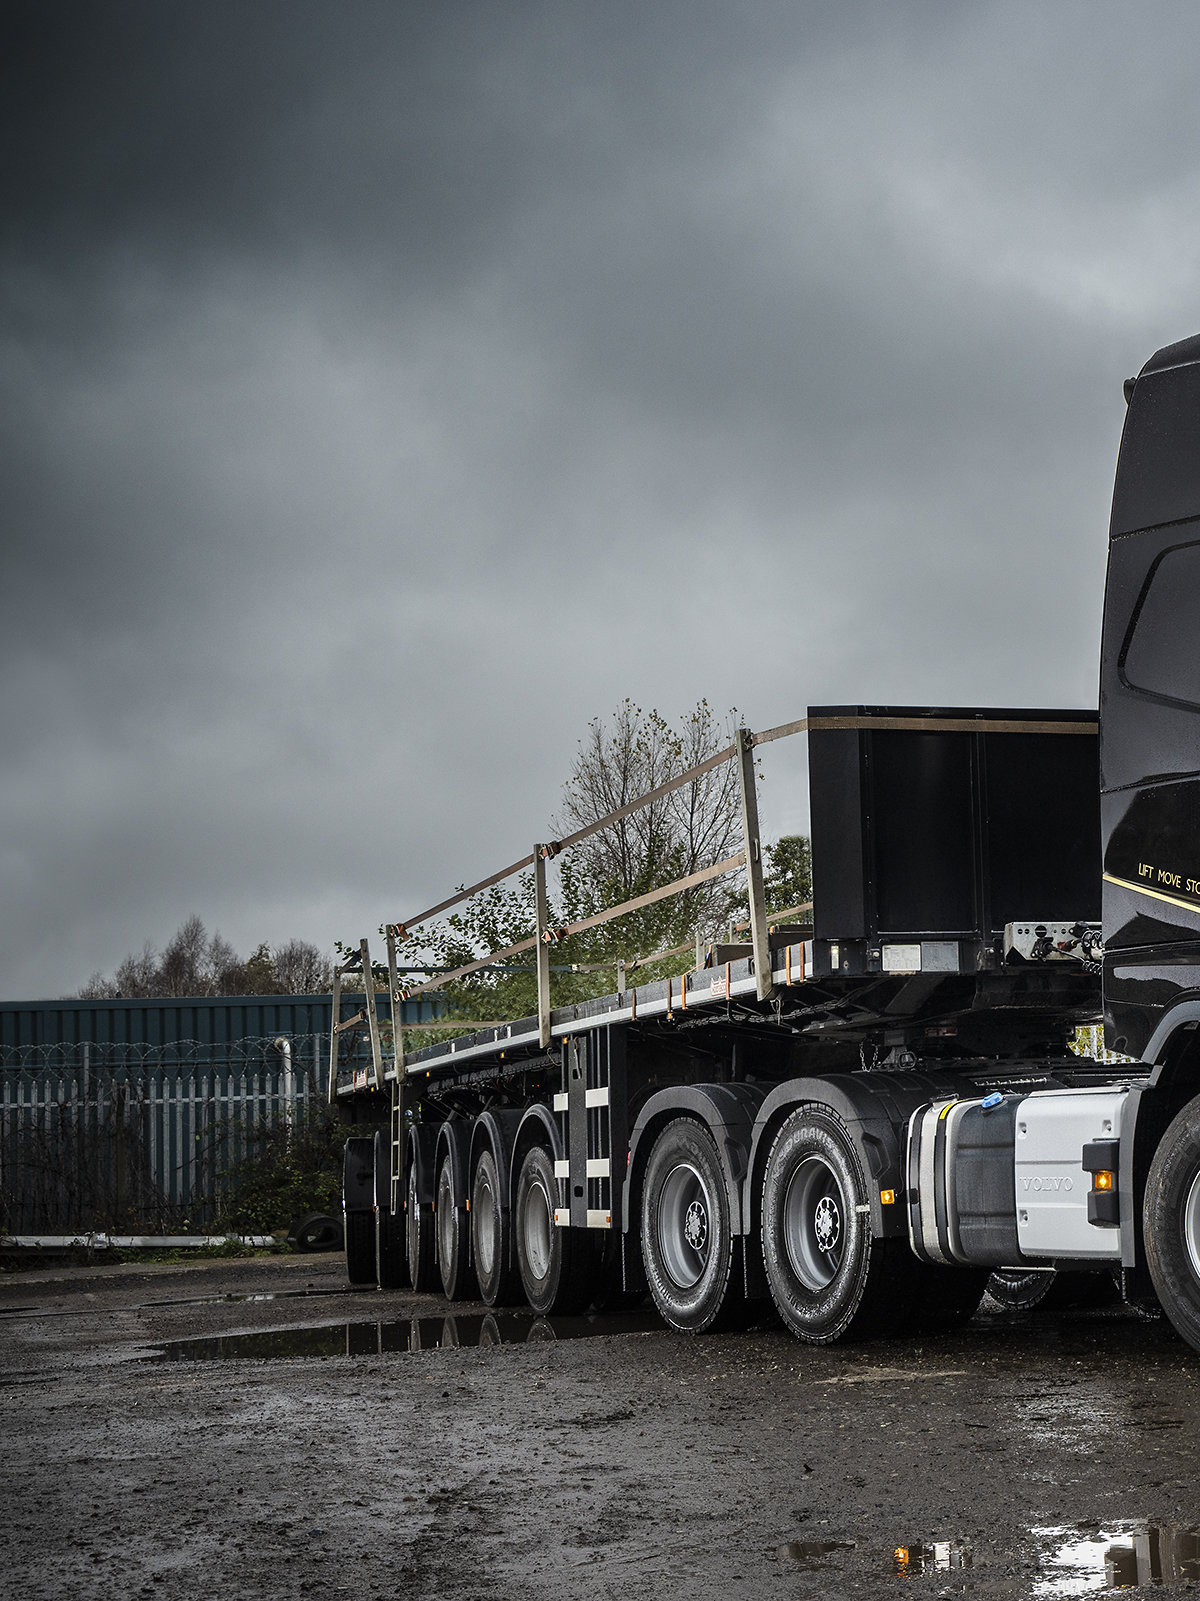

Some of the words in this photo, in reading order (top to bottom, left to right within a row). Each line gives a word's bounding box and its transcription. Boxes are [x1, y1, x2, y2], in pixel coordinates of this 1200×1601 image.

[1138, 862, 1154, 879] LIFT
[1157, 869, 1182, 889] MOVE
[1019, 1176, 1074, 1192] VOLVO
